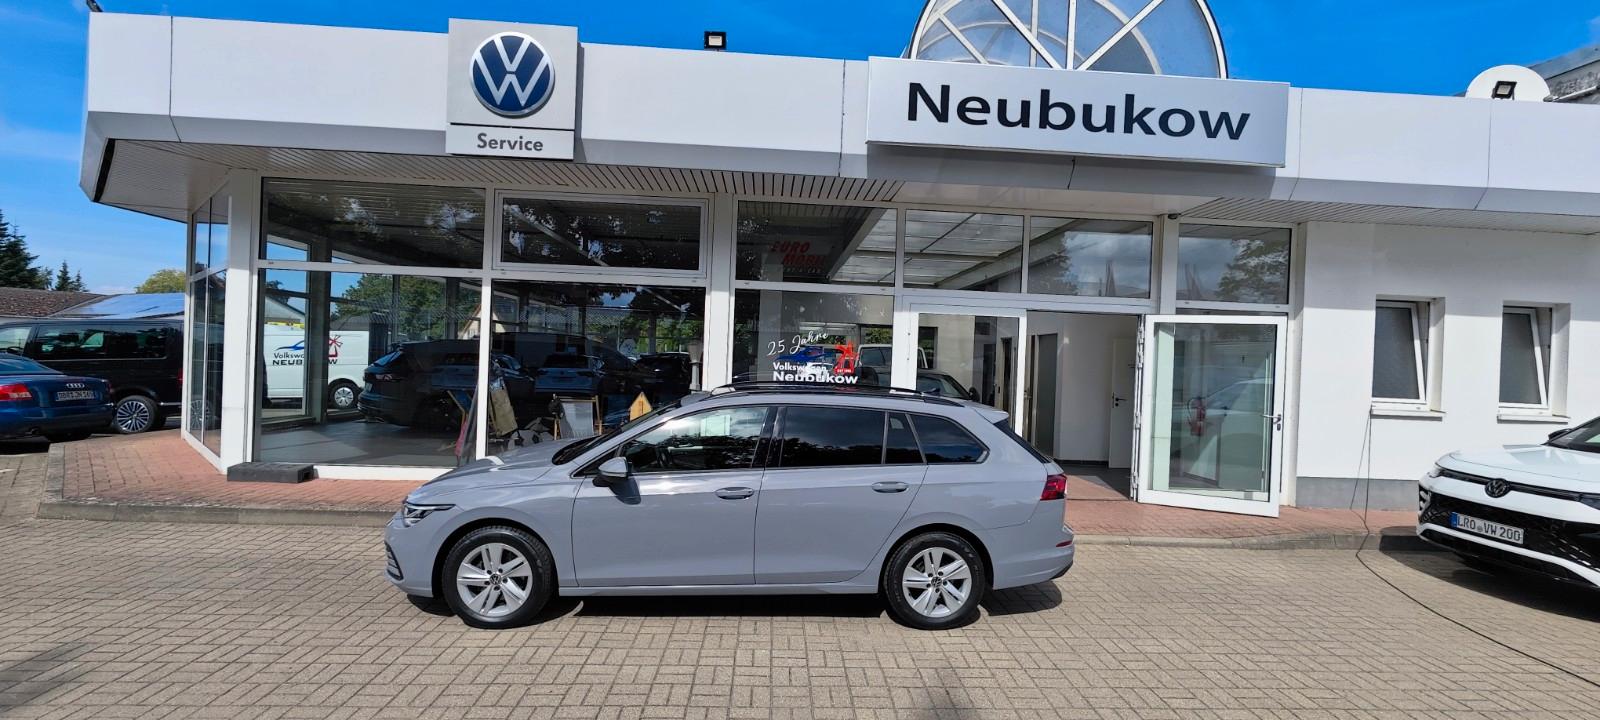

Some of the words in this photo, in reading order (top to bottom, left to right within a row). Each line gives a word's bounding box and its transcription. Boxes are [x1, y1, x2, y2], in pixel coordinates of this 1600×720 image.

[907, 82, 1251, 141] Neubukow
[477, 132, 544, 152] Service
[767, 339, 786, 356] 25
[789, 330, 829, 355] Jahre
[772, 361, 827, 371] Volkswen
[772, 371, 859, 384] Neubukow
[1457, 514, 1476, 530] LRO
[1483, 521, 1497, 536] VW
[1499, 526, 1521, 542] 200
